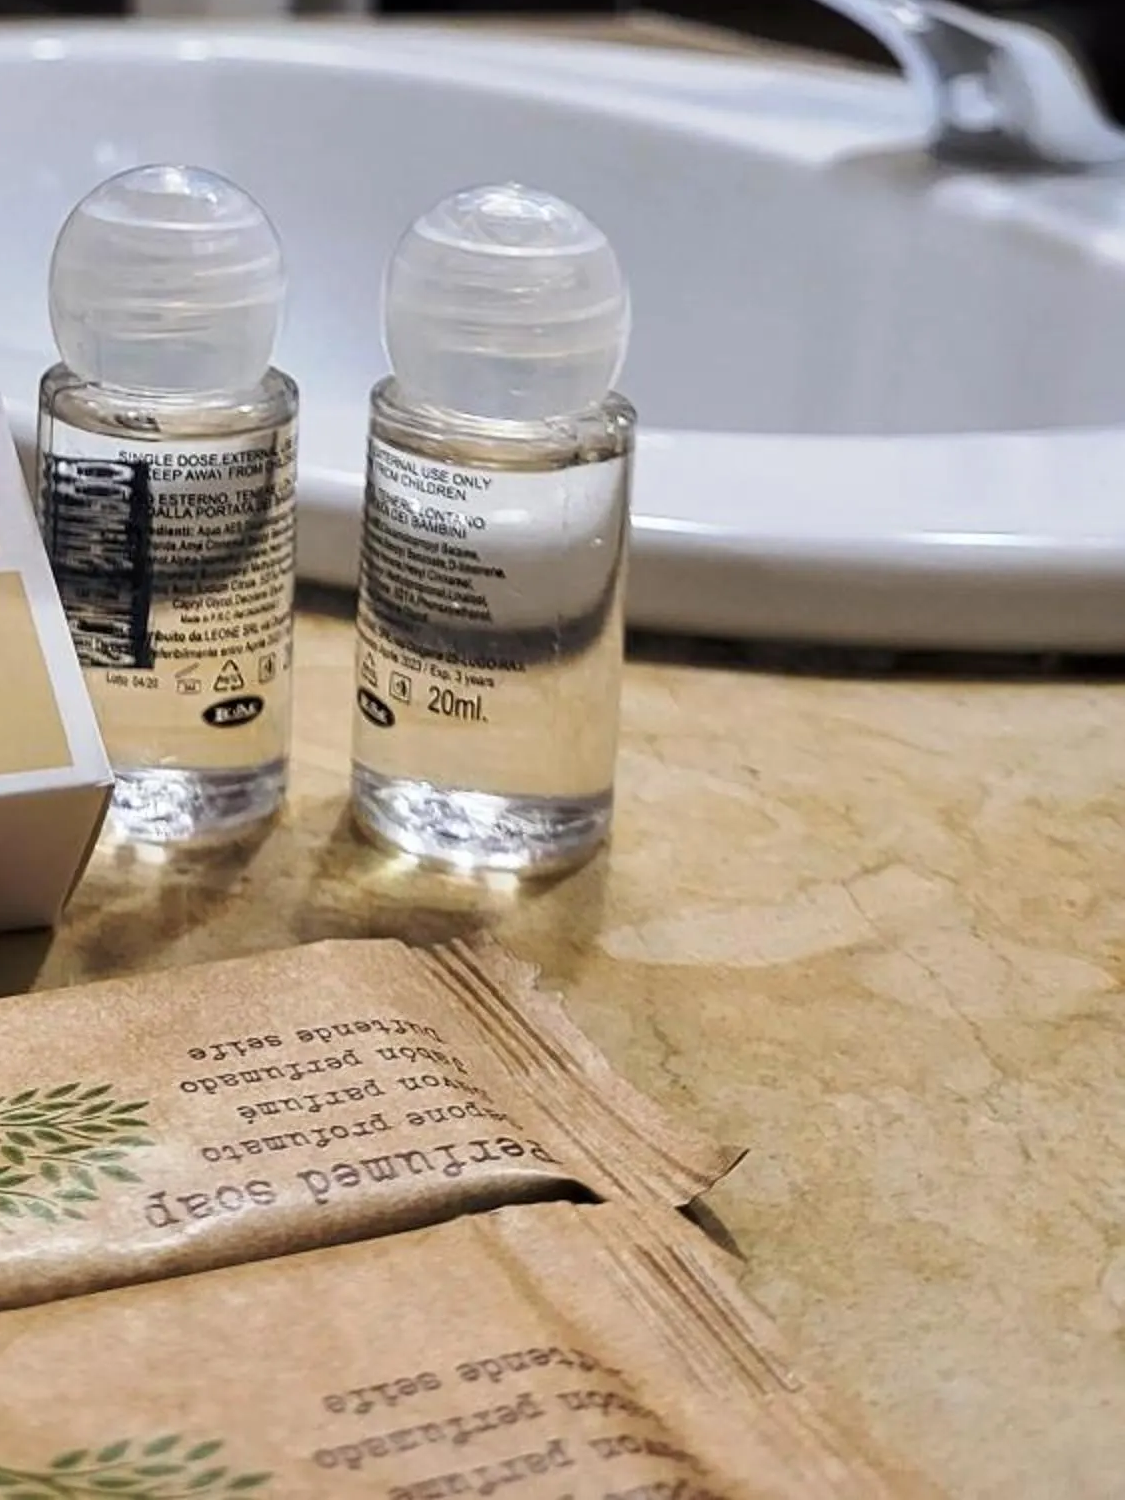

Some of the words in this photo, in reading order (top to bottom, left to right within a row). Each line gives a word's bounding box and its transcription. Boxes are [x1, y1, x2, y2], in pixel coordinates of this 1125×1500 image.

[118, 450, 173, 467] SINGLE
[185, 467, 223, 482] AWAY
[400, 474, 467, 501] CHILDREN
[421, 467, 449, 483] USE
[452, 473, 492, 491] ONLY
[411, 514, 467, 540] BAMBINI
[185, 1033, 282, 1064] seife
[295, 1017, 448, 1050] Duftende
[178, 1049, 362, 1097] perfumado
[235, 1079, 385, 1125] parfumé
[200, 1113, 392, 1166] profumato
[298, 1135, 562, 1205] Perfumed
[143, 1179, 277, 1232] soap
[321, 1372, 442, 1419] seife
